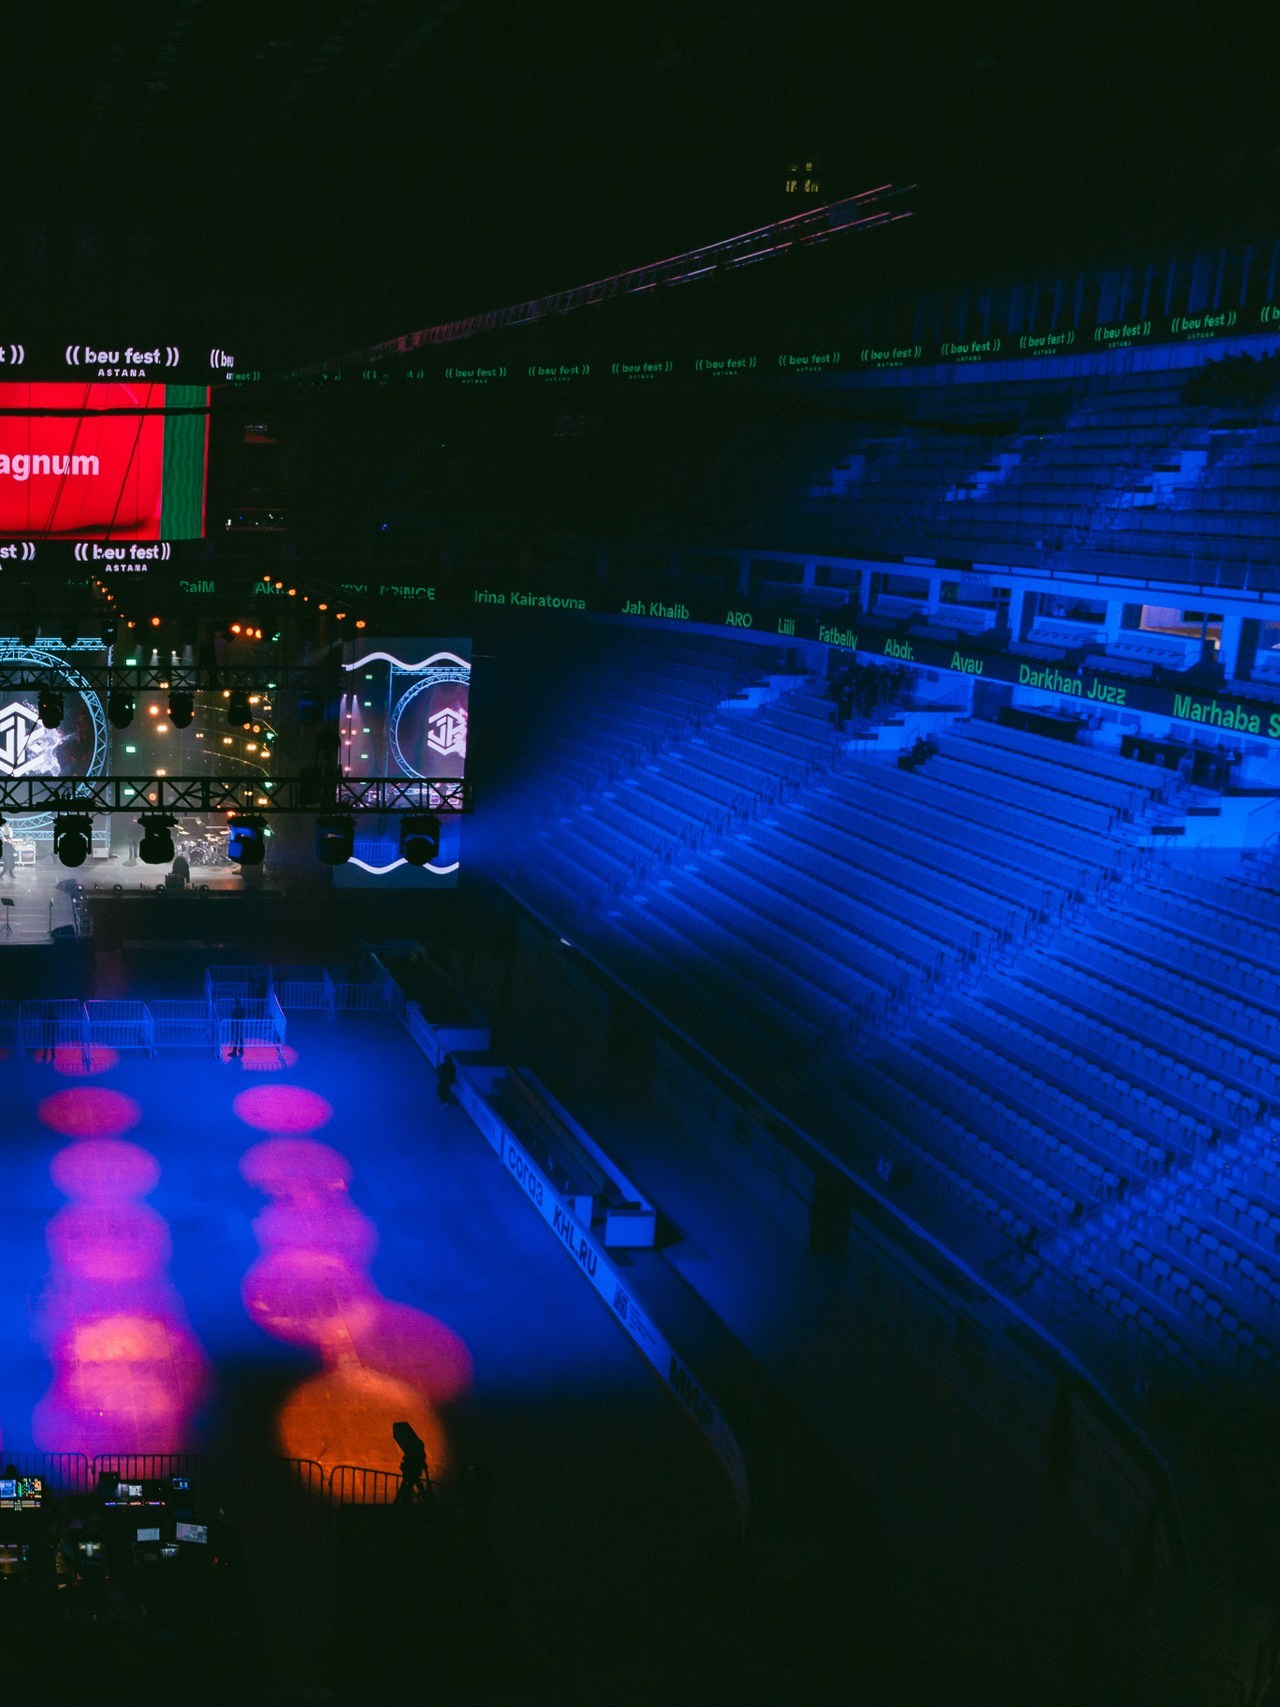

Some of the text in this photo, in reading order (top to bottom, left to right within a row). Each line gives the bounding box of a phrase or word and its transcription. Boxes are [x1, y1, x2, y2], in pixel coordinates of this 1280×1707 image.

[1204, 314, 1225, 328] fest
[1122, 324, 1142, 338] fest
[1048, 332, 1066, 346] fest
[892, 347, 912, 360] fest
[971, 341, 991, 353] fest
[84, 346, 161, 364] beu fest
[221, 351, 235, 368] beu
[810, 352, 831, 364] fest
[559, 365, 579, 375] fest
[643, 361, 664, 372] fest
[727, 358, 747, 369] fest
[97, 368, 146, 378] ASTANA
[477, 366, 497, 378] fest
[92, 543, 159, 560] beu fest
[105, 564, 148, 572] ASTANA
[474, 589, 586, 610] Irina Kairatovna
[622, 600, 690, 620] Jah Khalib
[725, 611, 753, 628] ARO
[777, 618, 796, 636] Liili
[1019, 664, 1127, 706] Darkhan Juzz
[1173, 694, 1261, 734] Marhaba
[552, 1204, 598, 1277] KHL.RU
